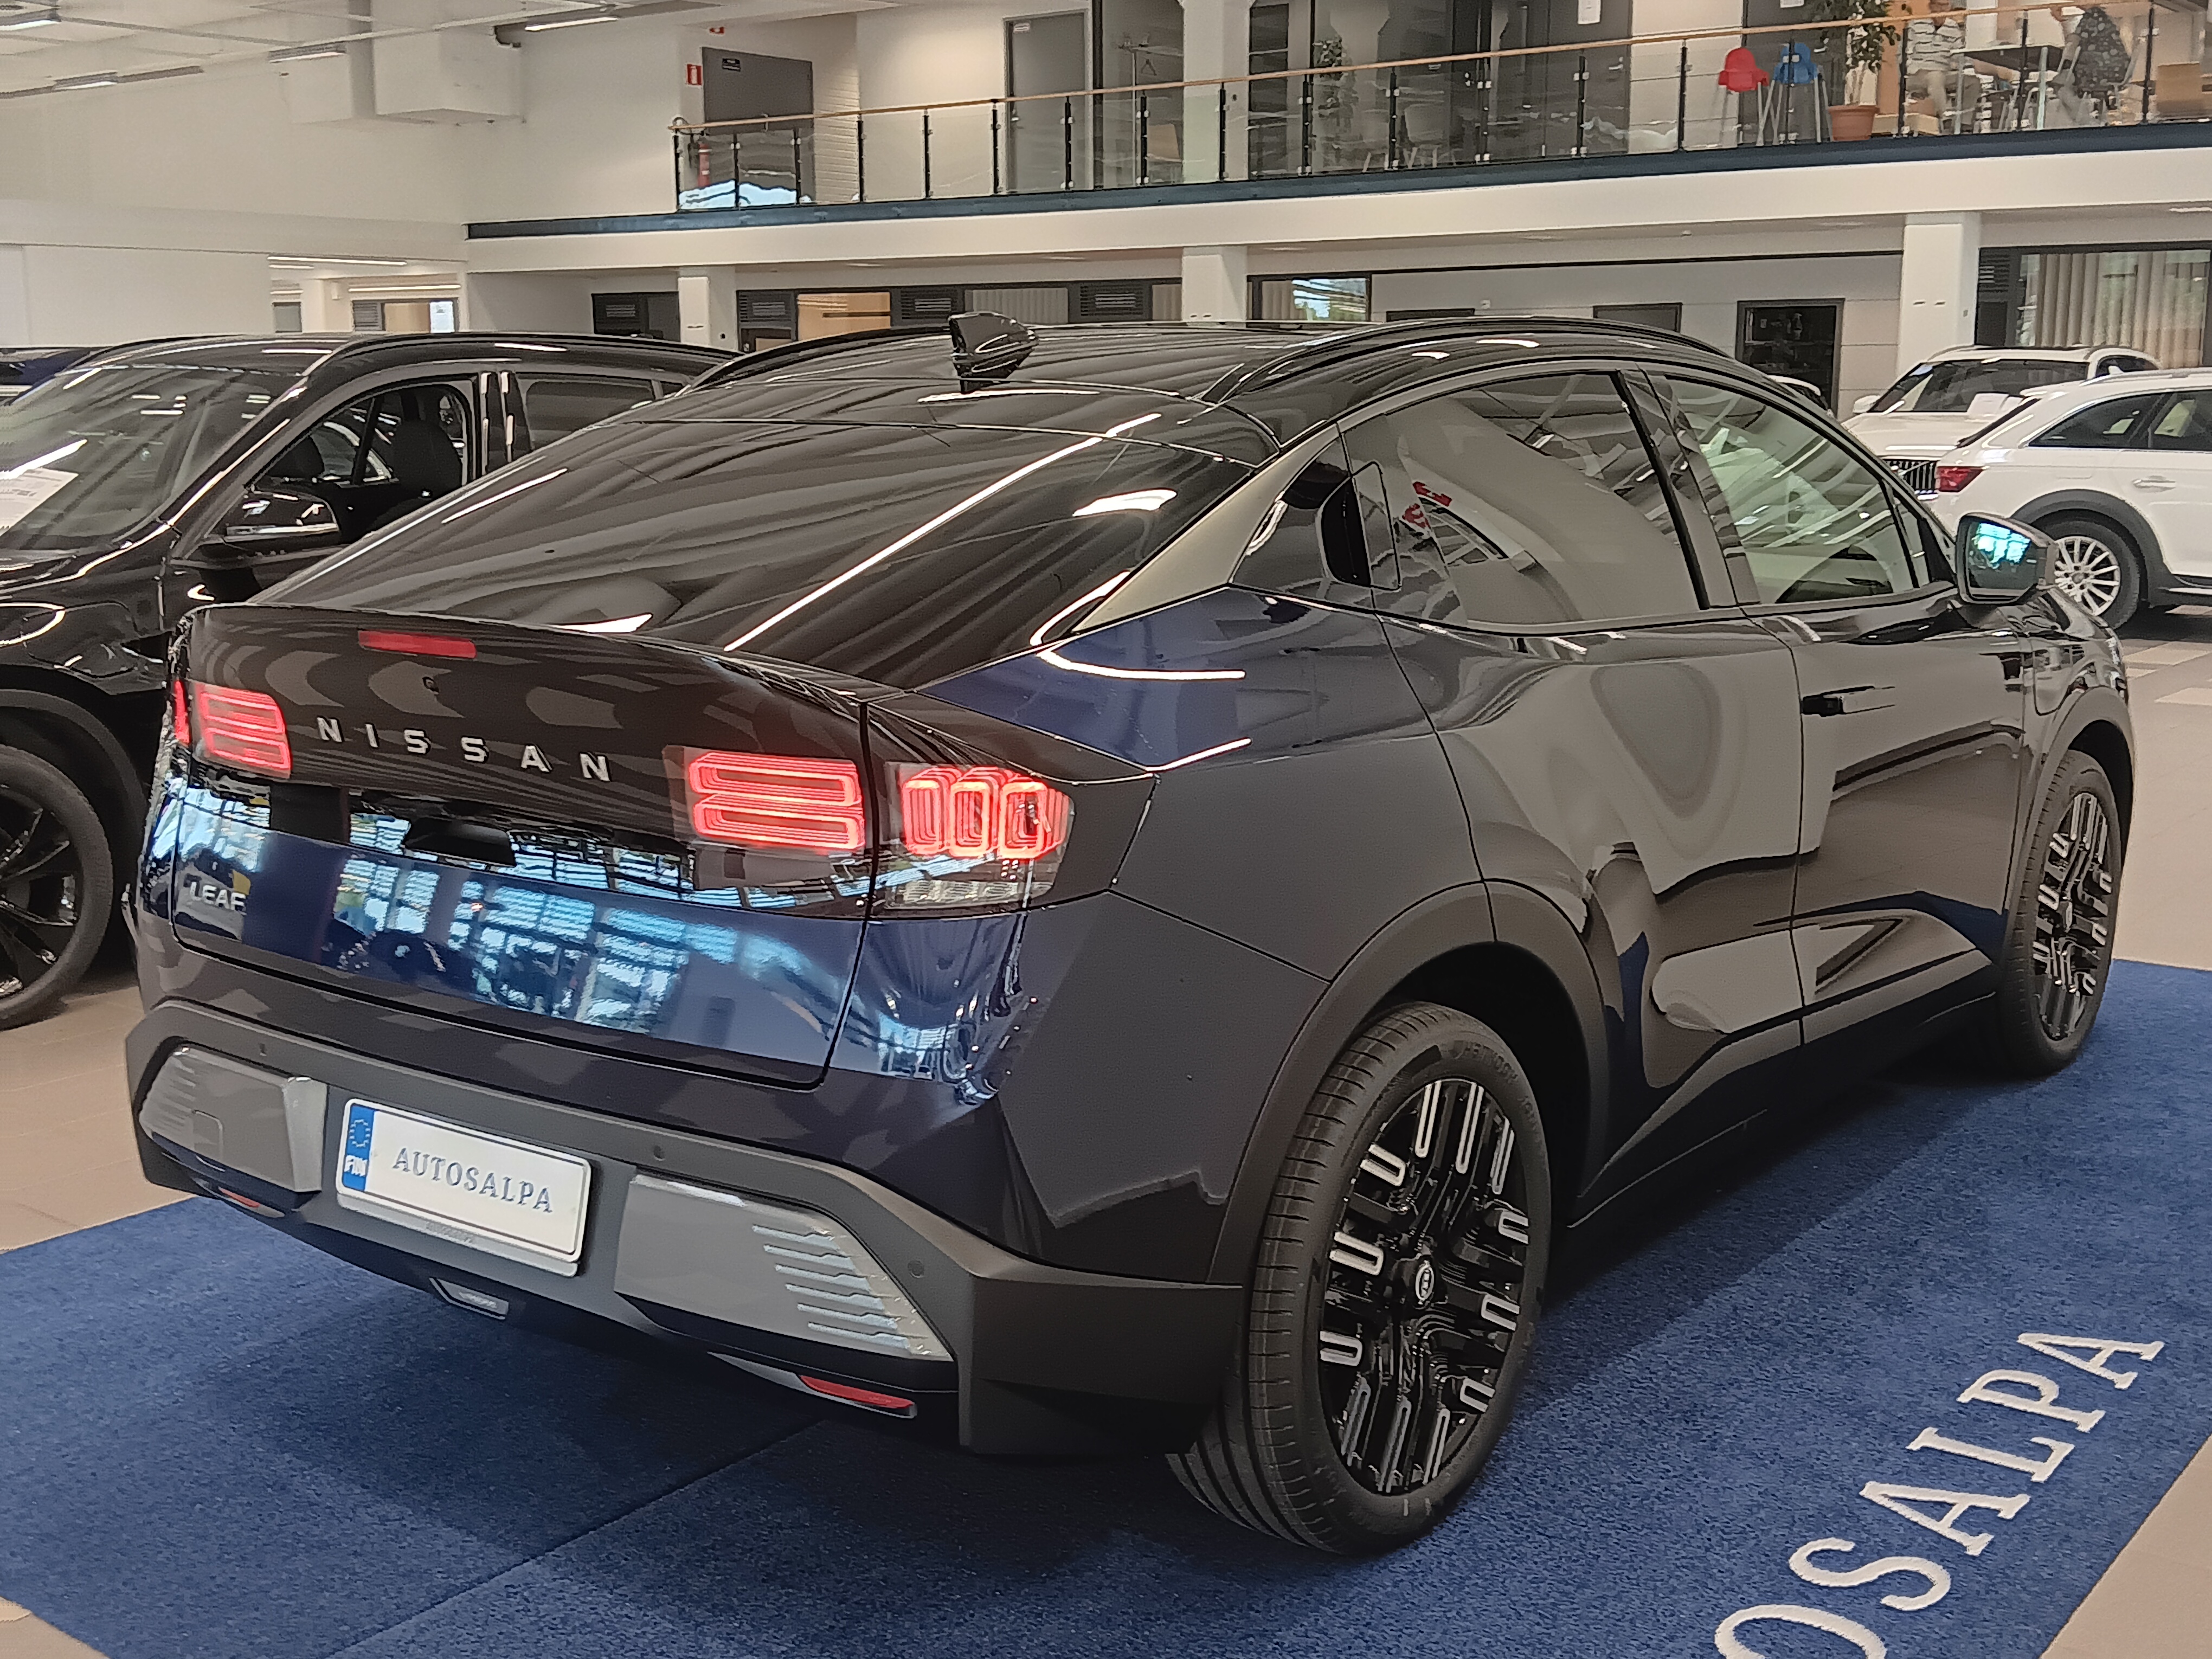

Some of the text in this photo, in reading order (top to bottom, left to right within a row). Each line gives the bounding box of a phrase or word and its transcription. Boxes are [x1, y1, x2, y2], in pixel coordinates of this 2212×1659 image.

[317, 717, 610, 782] NISSAN
[190, 881, 246, 911] LEAF
[393, 1147, 552, 1213] AUTOSALPA
